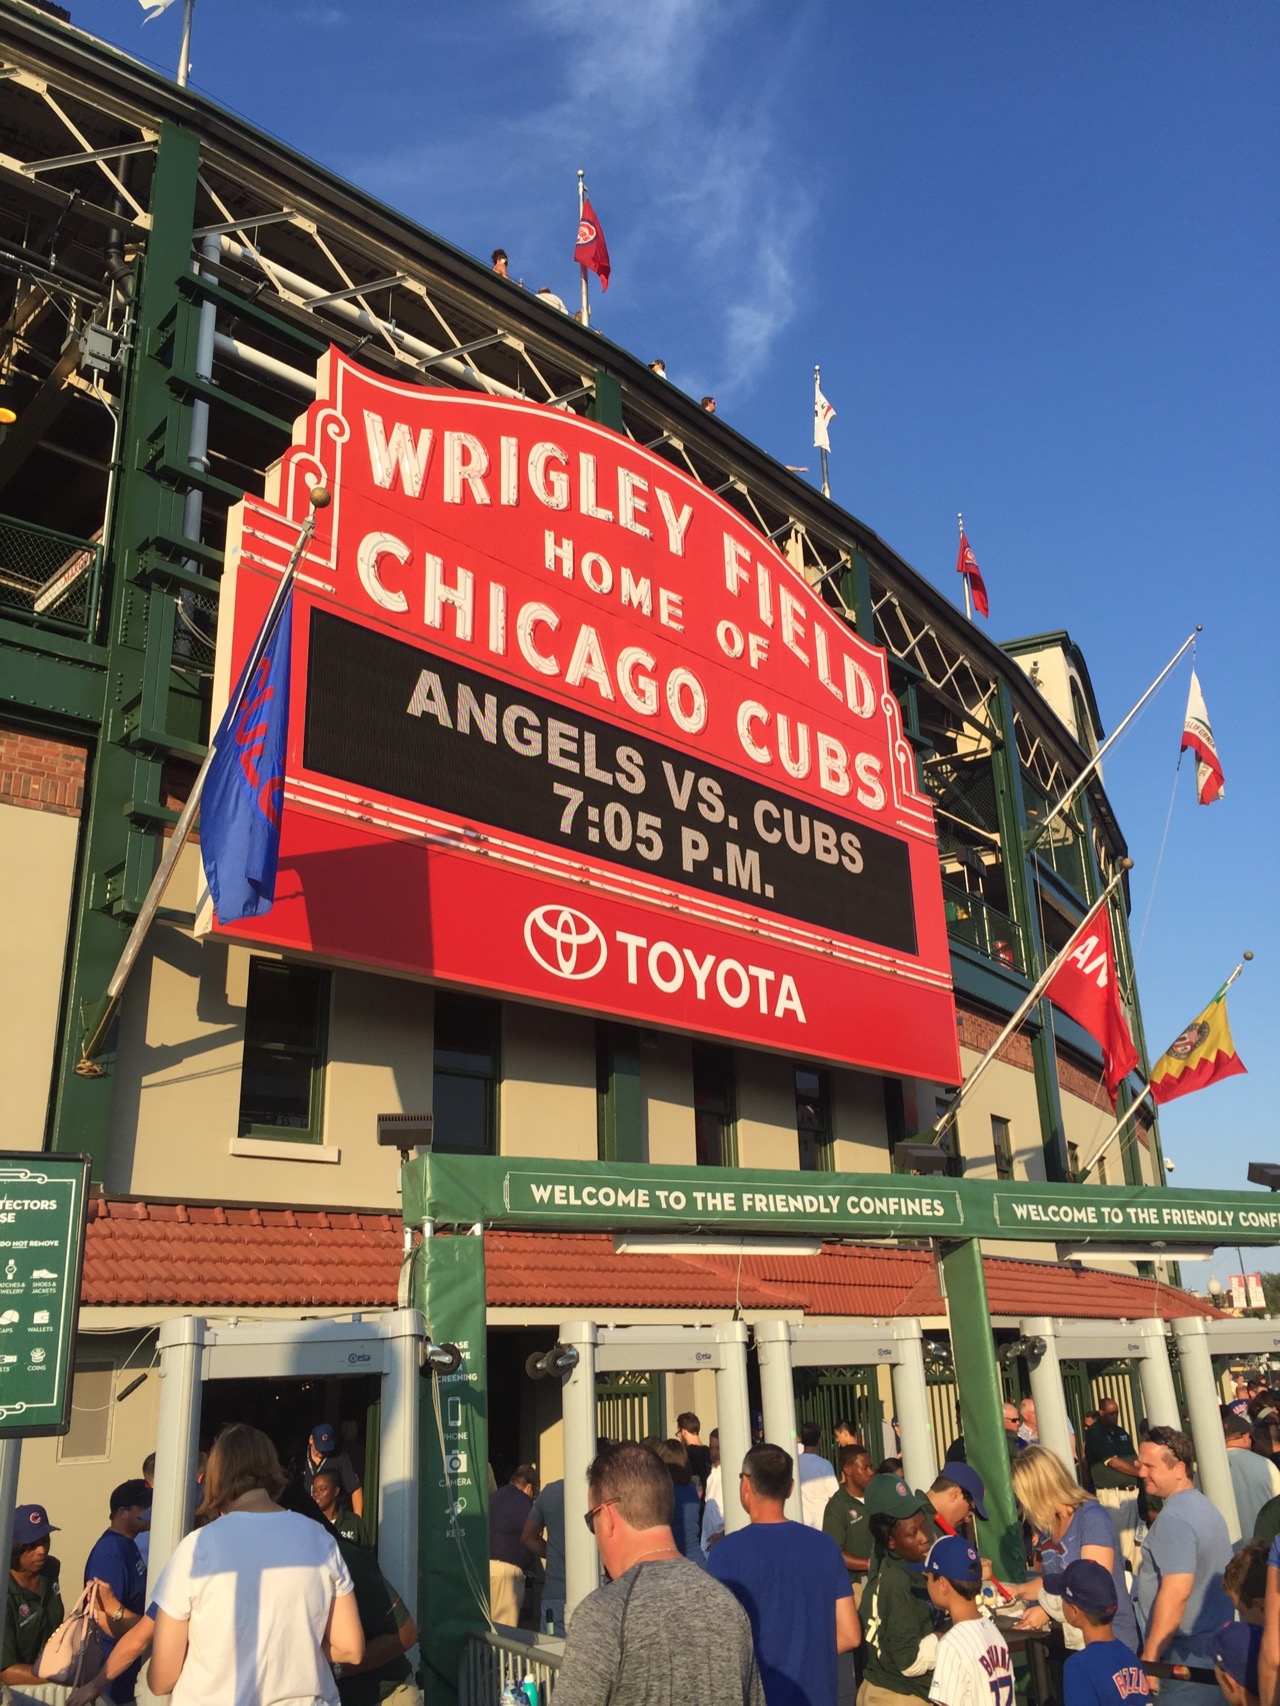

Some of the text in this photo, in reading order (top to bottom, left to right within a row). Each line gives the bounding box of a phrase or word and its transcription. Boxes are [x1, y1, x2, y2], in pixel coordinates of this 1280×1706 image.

[362, 408, 876, 718] WRIGLEY FIELD
[544, 529, 769, 669] HOME OF
[356, 531, 886, 810] CHICAGO CUBS
[405, 668, 864, 874] ANGELS VS. CUBS
[552, 782, 774, 898] 7:05 P.M.
[615, 930, 807, 1023] TOYOTA
[12, 1240, 29, 1248] NOT
[530, 1183, 945, 1217] WELCOME TO THE FRIENDLY CONFINES
[1012, 1203, 1098, 1224] WELCOME
[1101, 1207, 1124, 1224] TO
[1126, 1207, 1159, 1225] THE
[1162, 1208, 1234, 1227] FRIENDLY
[437, 1373, 478, 1383] CREENING
